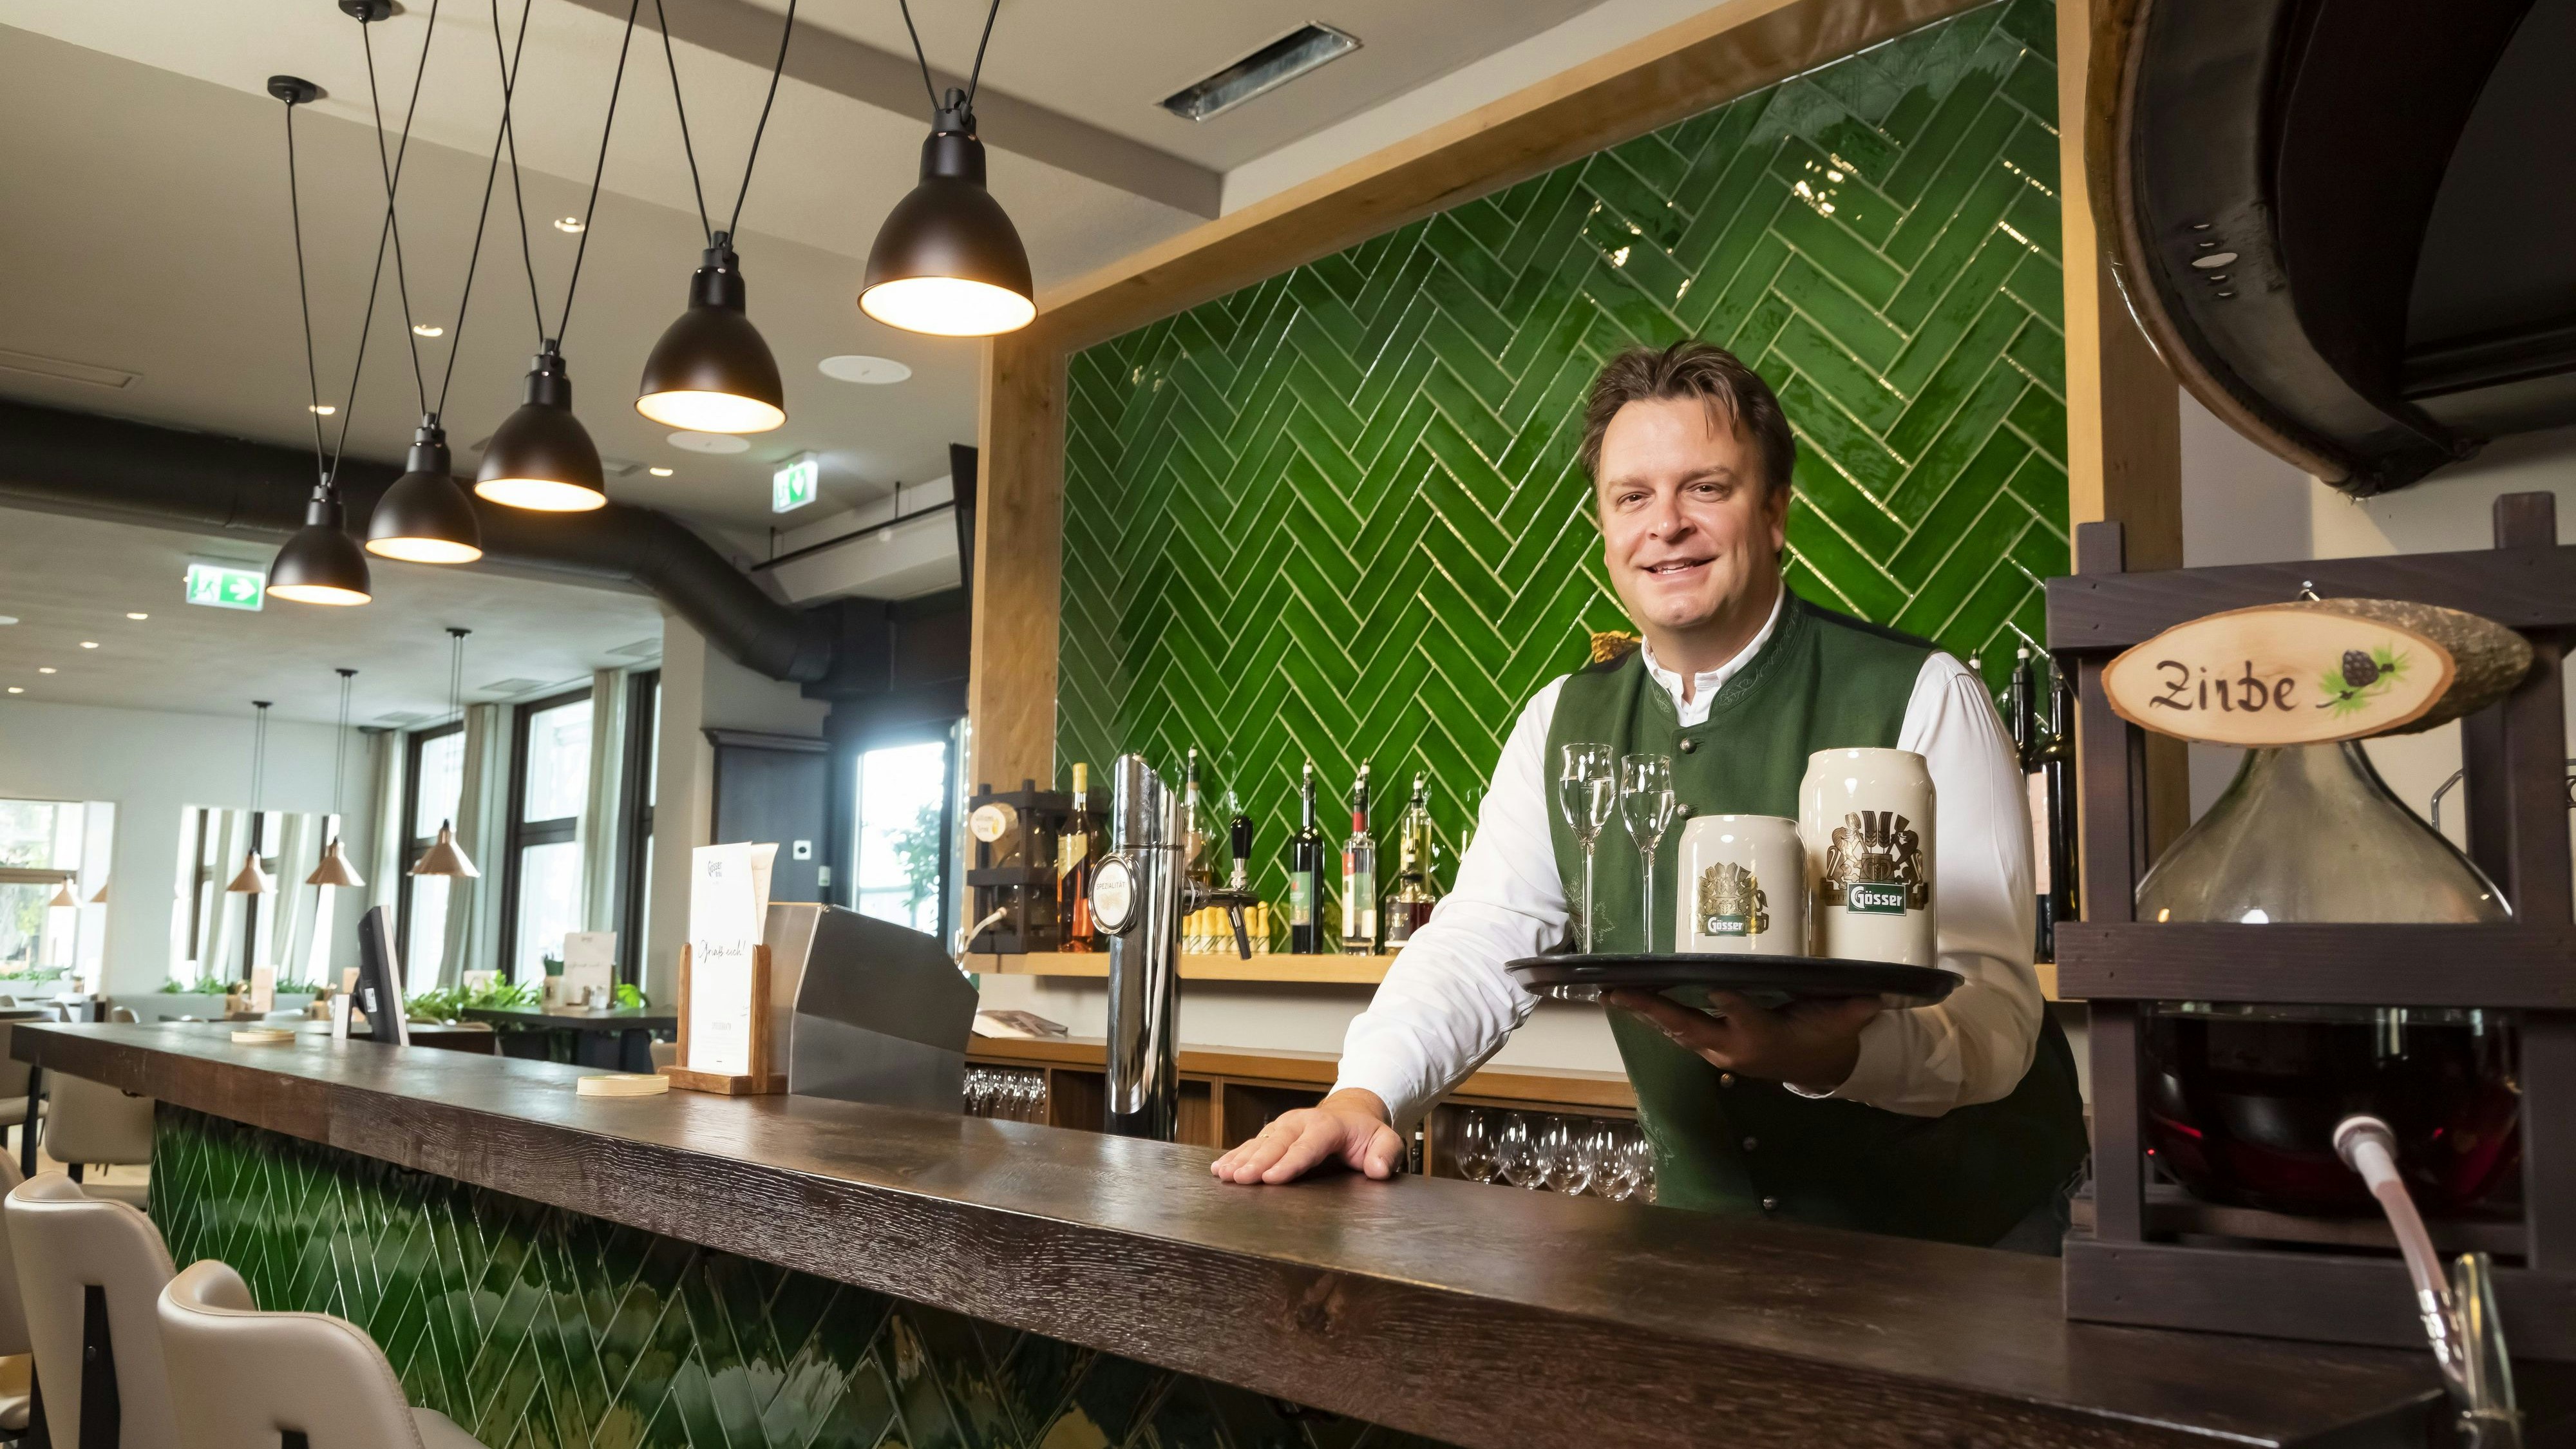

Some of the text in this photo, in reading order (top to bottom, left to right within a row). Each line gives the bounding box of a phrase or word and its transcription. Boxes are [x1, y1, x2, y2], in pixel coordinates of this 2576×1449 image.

[2149, 659, 2299, 712] Zirbe
[1096, 880, 1126, 890] SPEZIALITÄT
[1850, 886, 1902, 909] Gösser
[1707, 916, 1743, 933] Gösser
